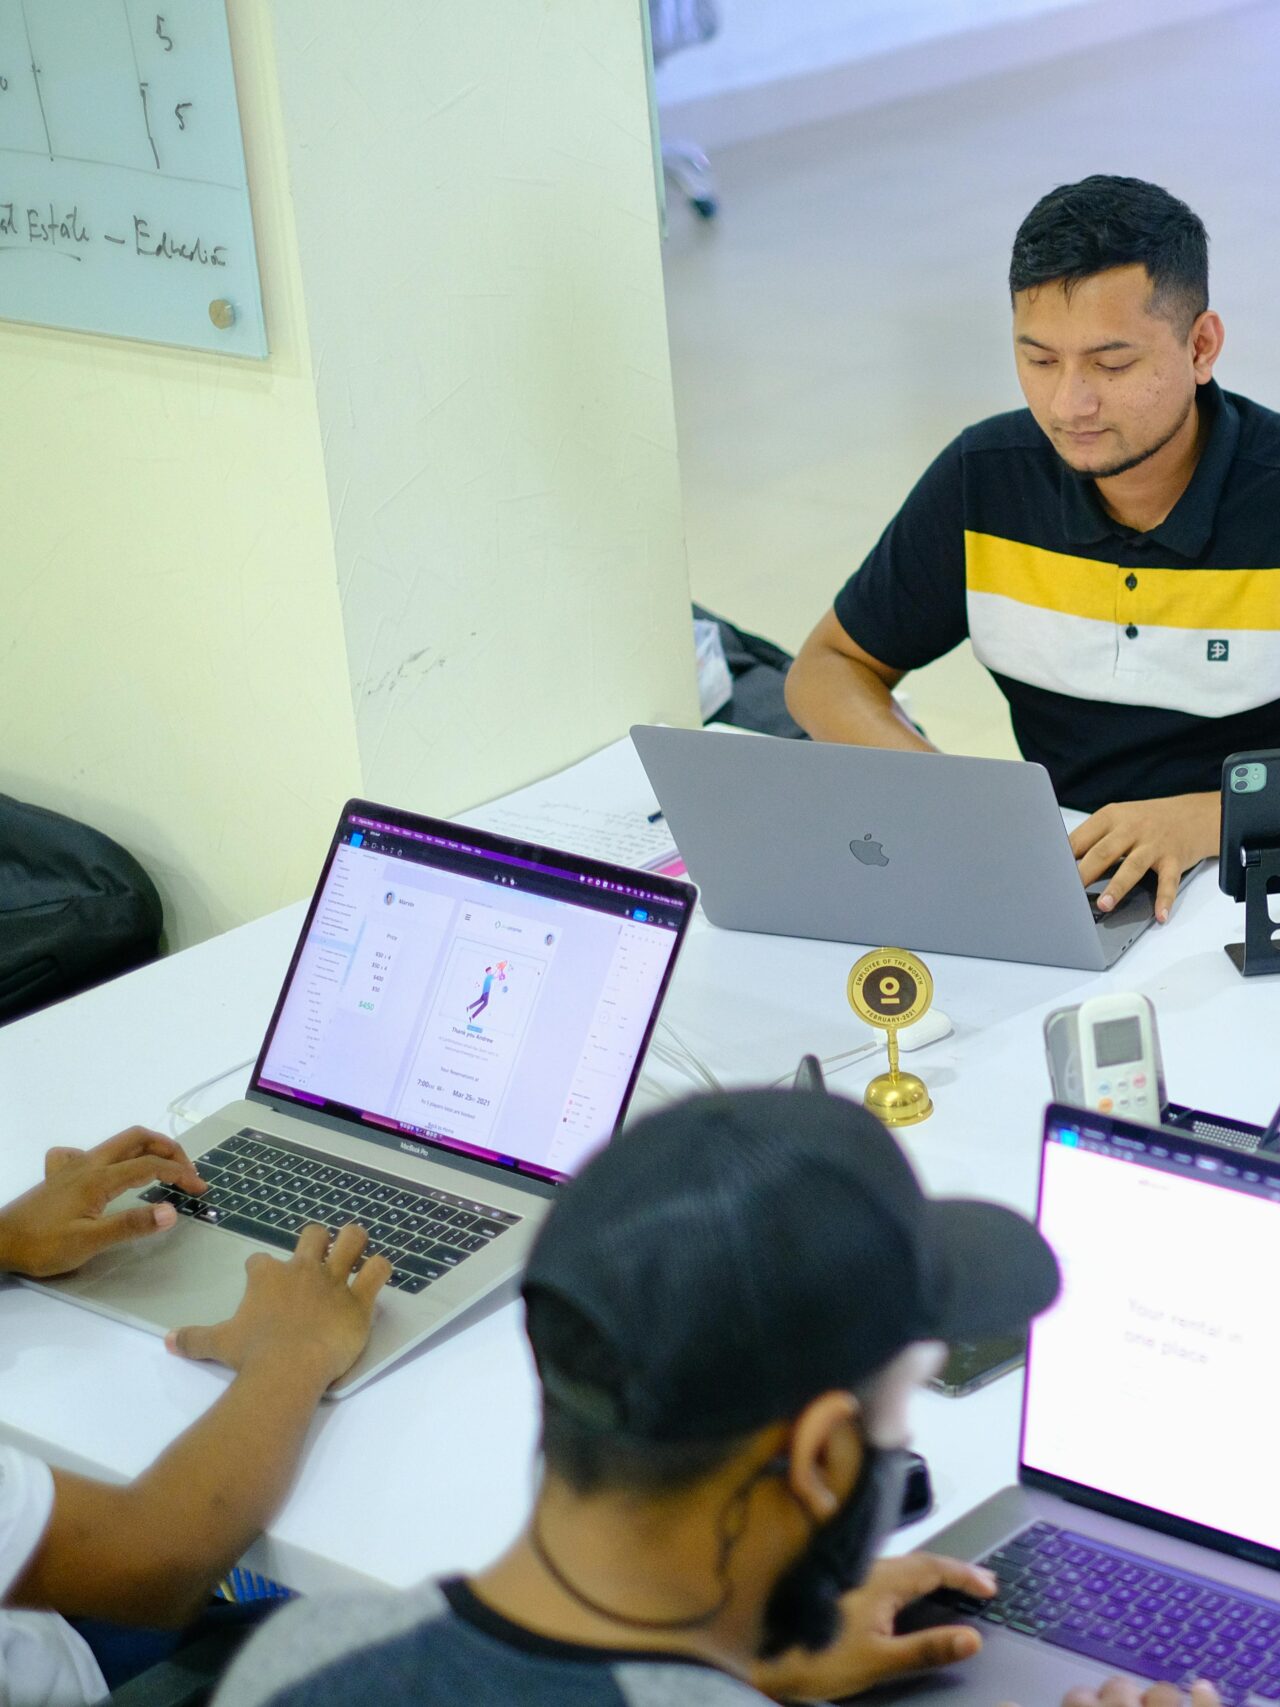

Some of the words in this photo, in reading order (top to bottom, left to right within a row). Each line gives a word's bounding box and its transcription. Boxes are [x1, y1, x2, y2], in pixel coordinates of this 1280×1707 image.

[856, 960, 880, 986] EMPLOYEE
[894, 959, 907, 968] THE
[908, 965, 924, 985] MONTH
